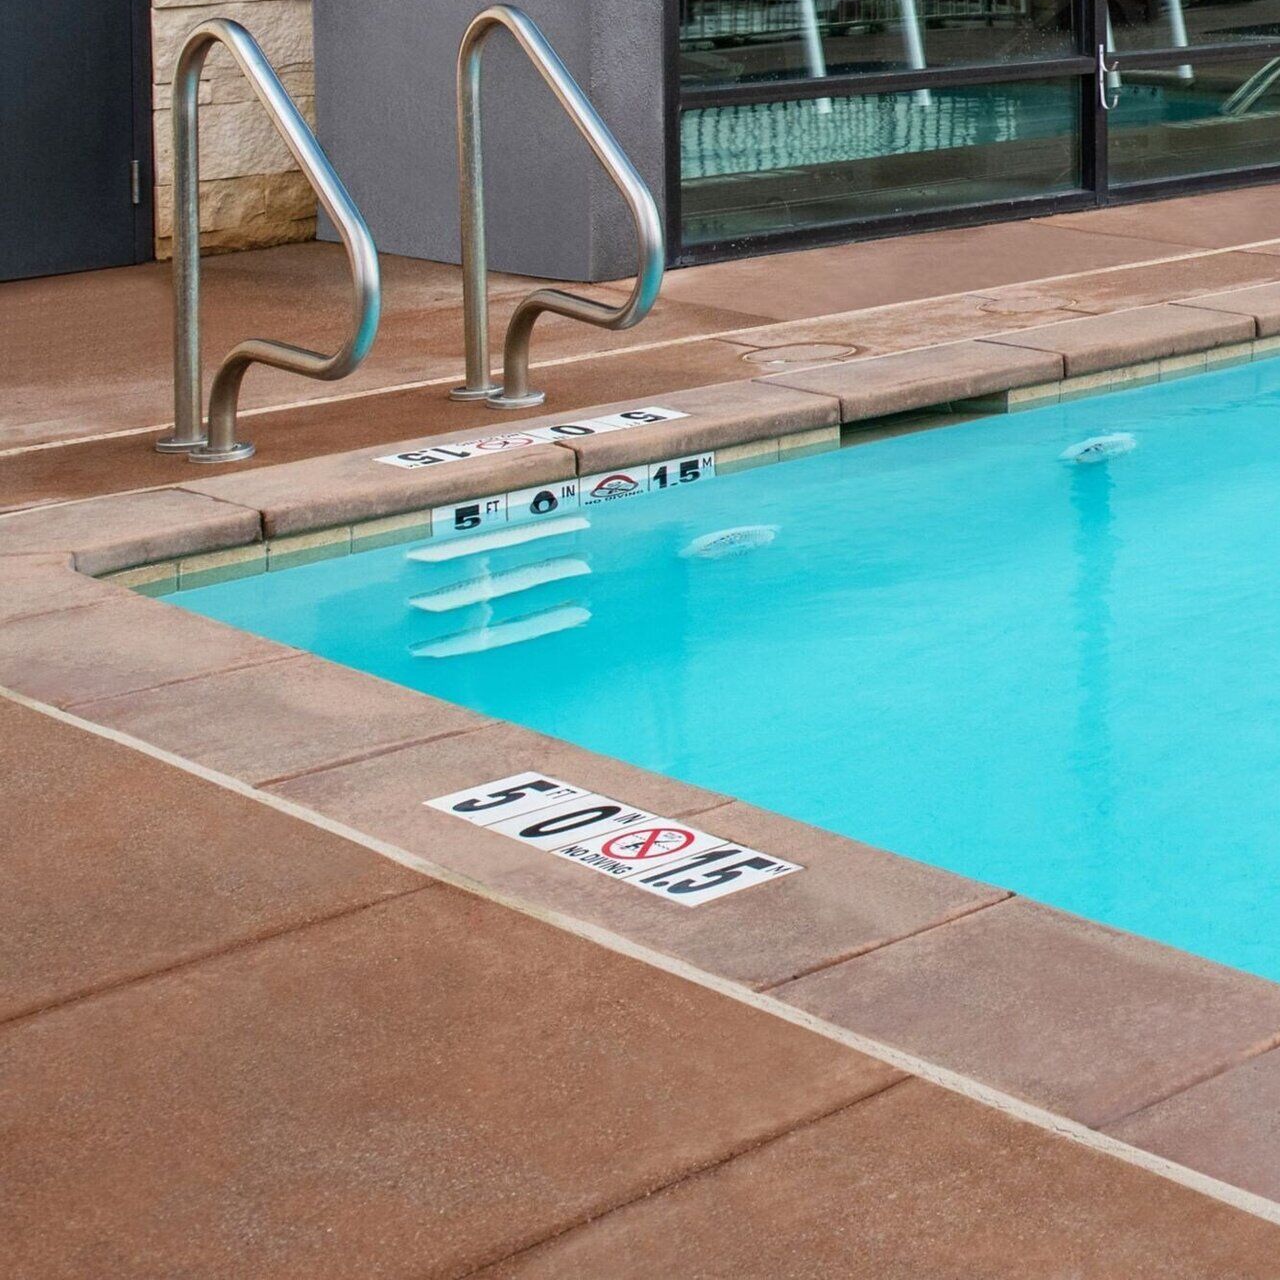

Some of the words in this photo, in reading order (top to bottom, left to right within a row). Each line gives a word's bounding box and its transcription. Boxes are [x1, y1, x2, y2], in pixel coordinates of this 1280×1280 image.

[550, 425, 595, 435] 0
[454, 504, 482, 530] 5
[486, 500, 499, 515] FT
[562, 485, 576, 499] IN
[652, 459, 700, 489] 1.5
[702, 457, 713, 468] M
[452, 779, 560, 813] 5
[546, 787, 579, 801] FT
[518, 805, 622, 838] 0
[613, 812, 639, 826] IN
[559, 844, 588, 860] NO
[580, 851, 635, 876] DIVING
[638, 848, 778, 895] 1.5
[766, 864, 792, 876] M
